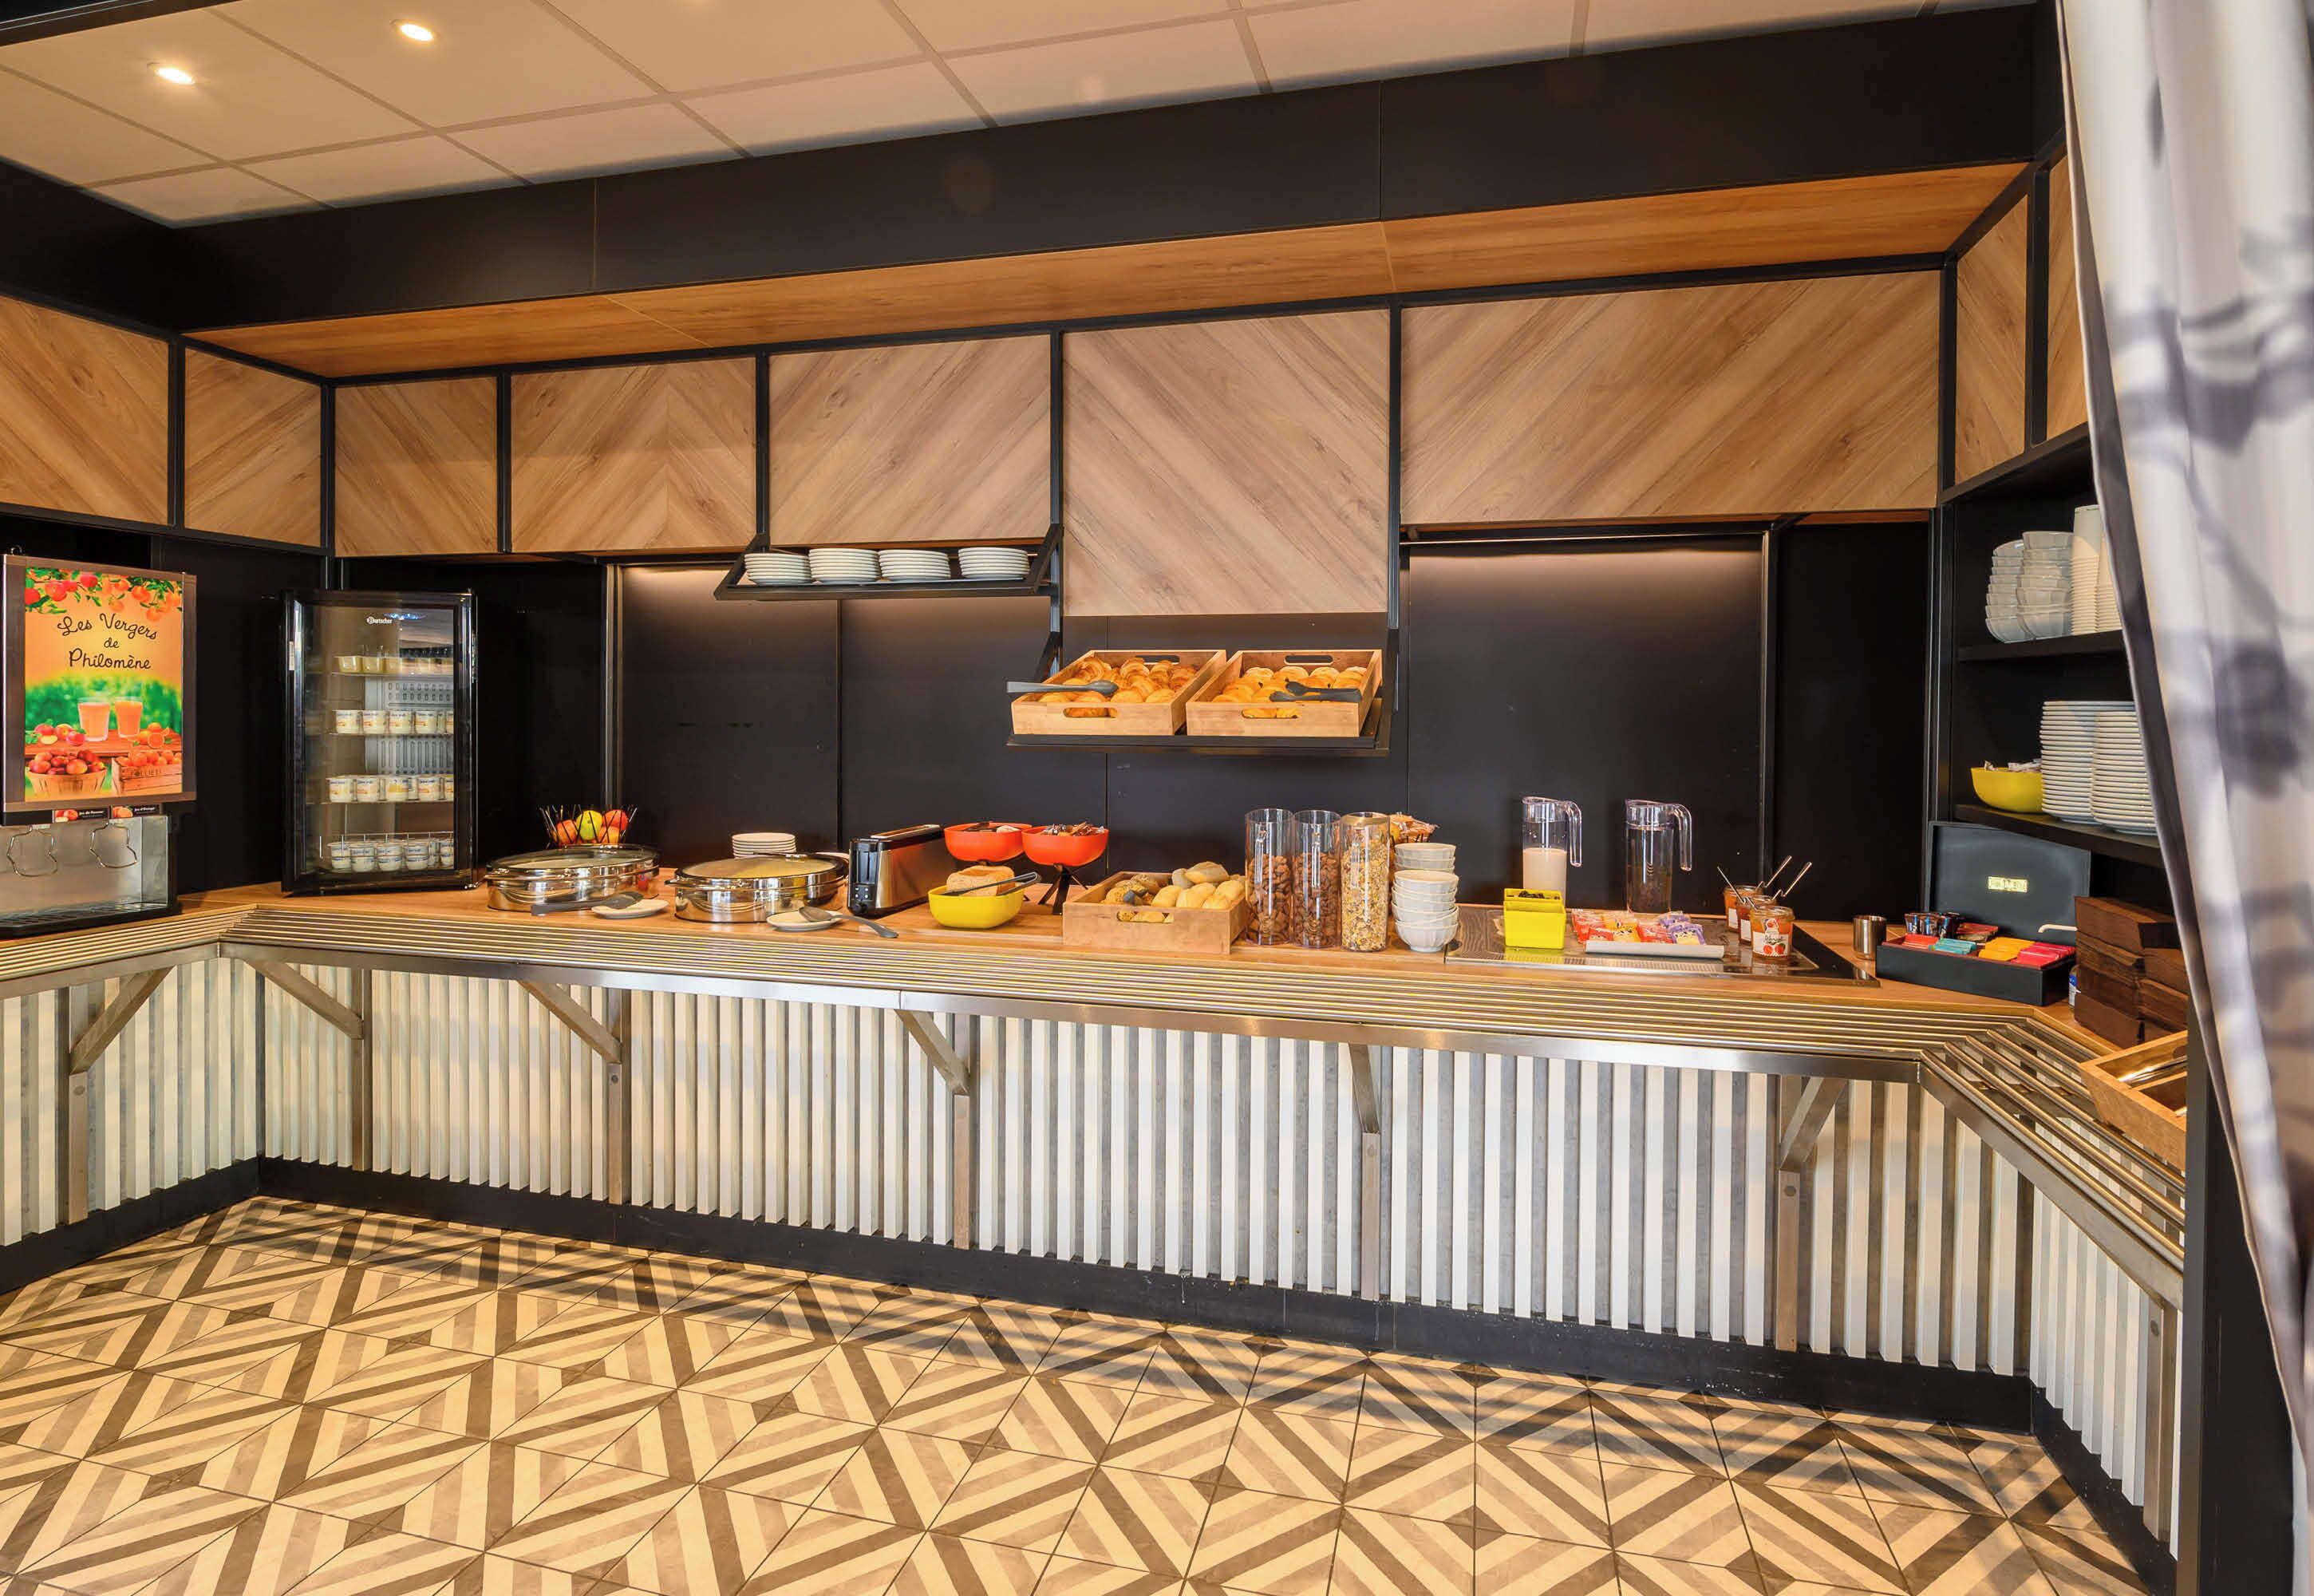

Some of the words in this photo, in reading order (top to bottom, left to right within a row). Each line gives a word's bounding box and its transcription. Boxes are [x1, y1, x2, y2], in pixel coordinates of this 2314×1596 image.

[57, 615, 93, 637] Les
[99, 612, 158, 640] Vergers
[103, 637, 120, 649] de
[69, 647, 152, 670] Philomène
